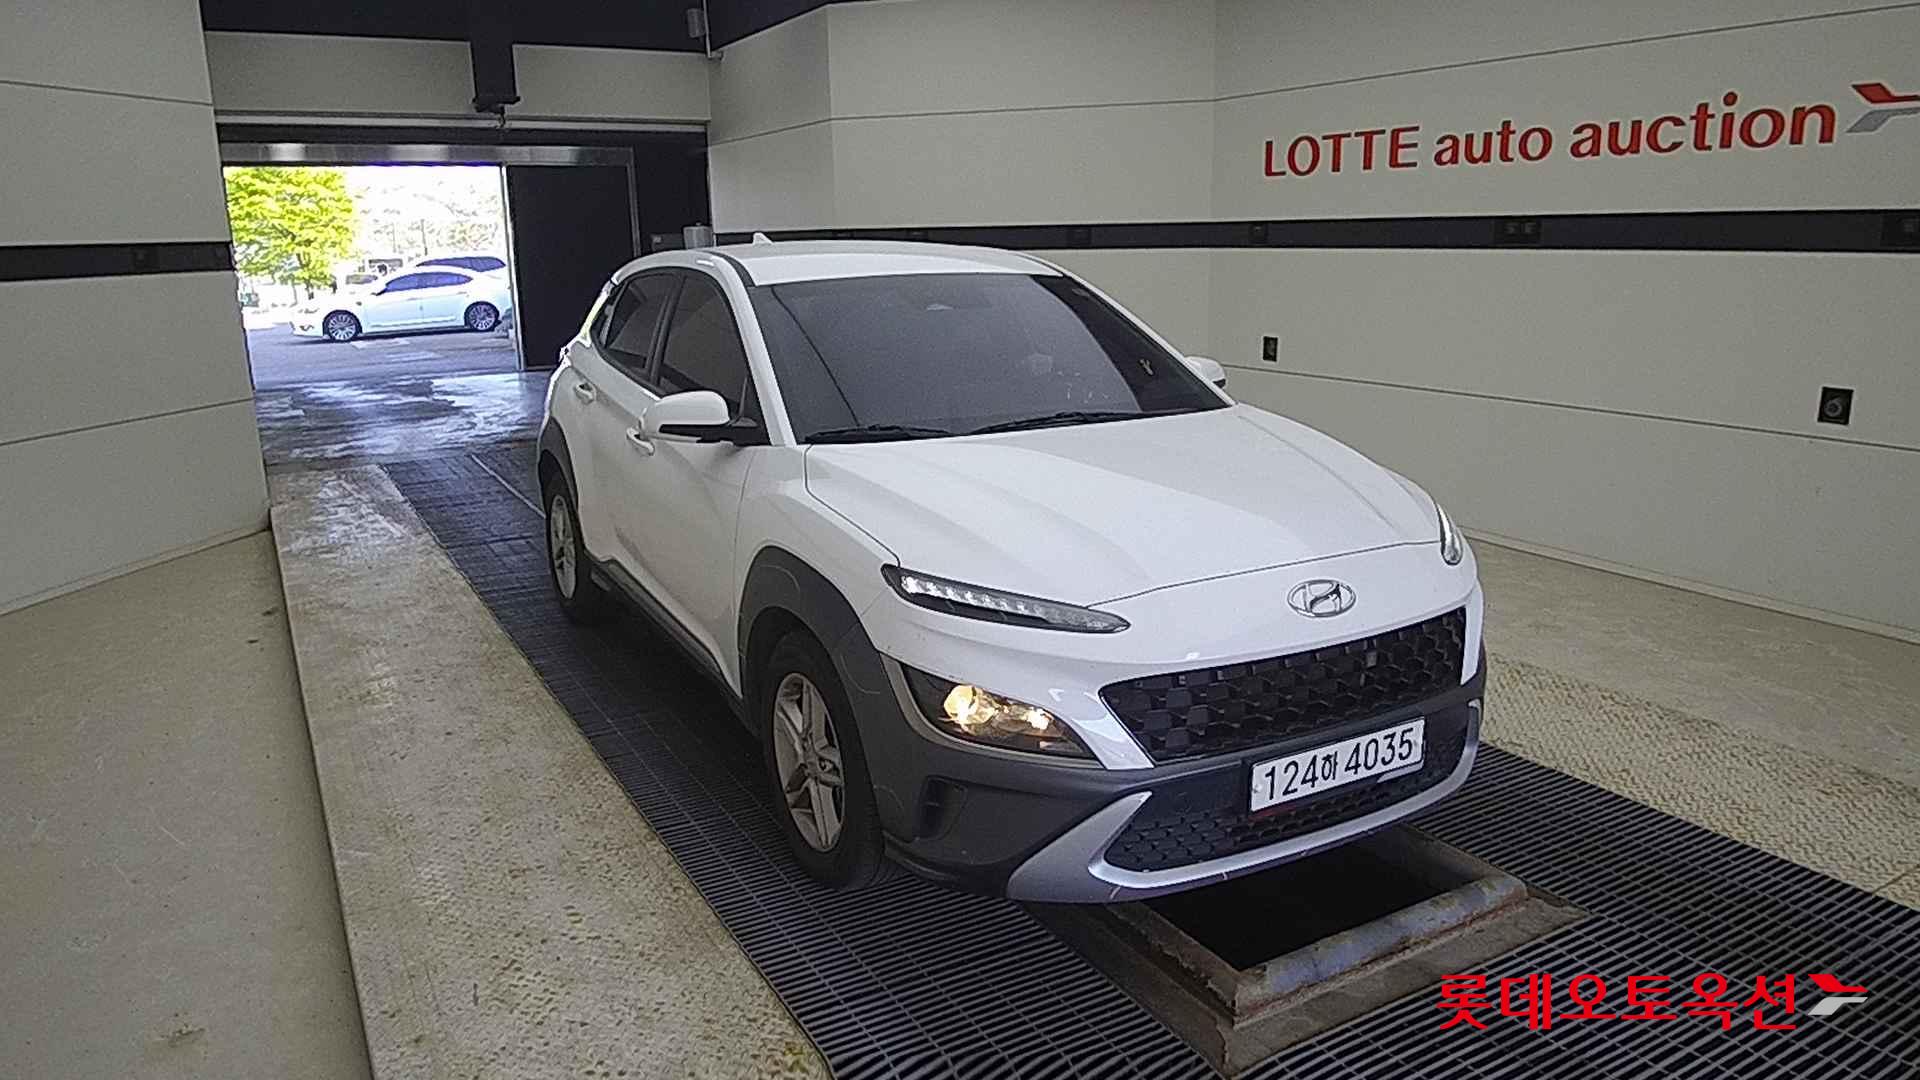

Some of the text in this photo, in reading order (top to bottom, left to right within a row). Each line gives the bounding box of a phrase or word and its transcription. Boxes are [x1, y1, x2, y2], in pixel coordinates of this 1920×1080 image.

[1264, 92, 1837, 177] LOTTE auto auction
[1265, 728, 1414, 801] 124하 4035
